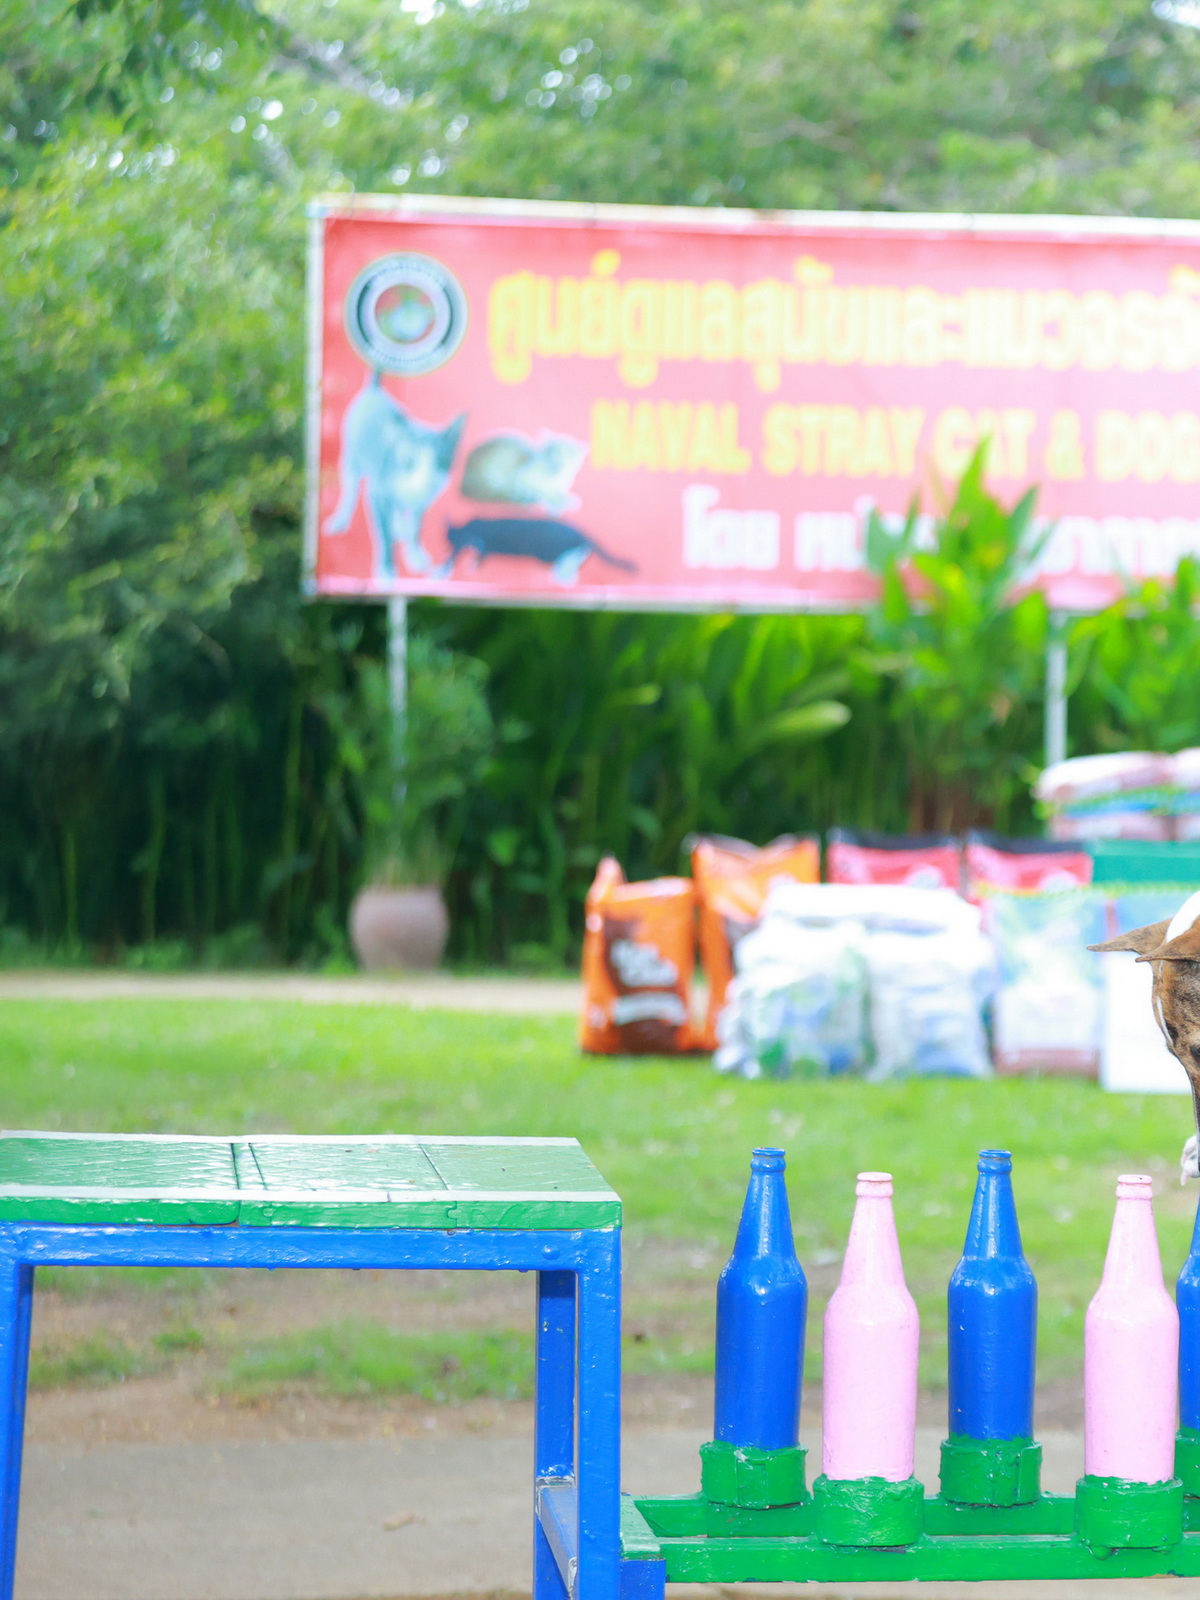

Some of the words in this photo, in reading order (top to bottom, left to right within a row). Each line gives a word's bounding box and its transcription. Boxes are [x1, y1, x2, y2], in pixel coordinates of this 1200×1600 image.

[590, 399, 751, 475] NAVAL
[762, 402, 926, 479] STRAY
[933, 405, 1037, 480] CAT
[1043, 408, 1086, 482] &
[681, 484, 780, 571] โดย
